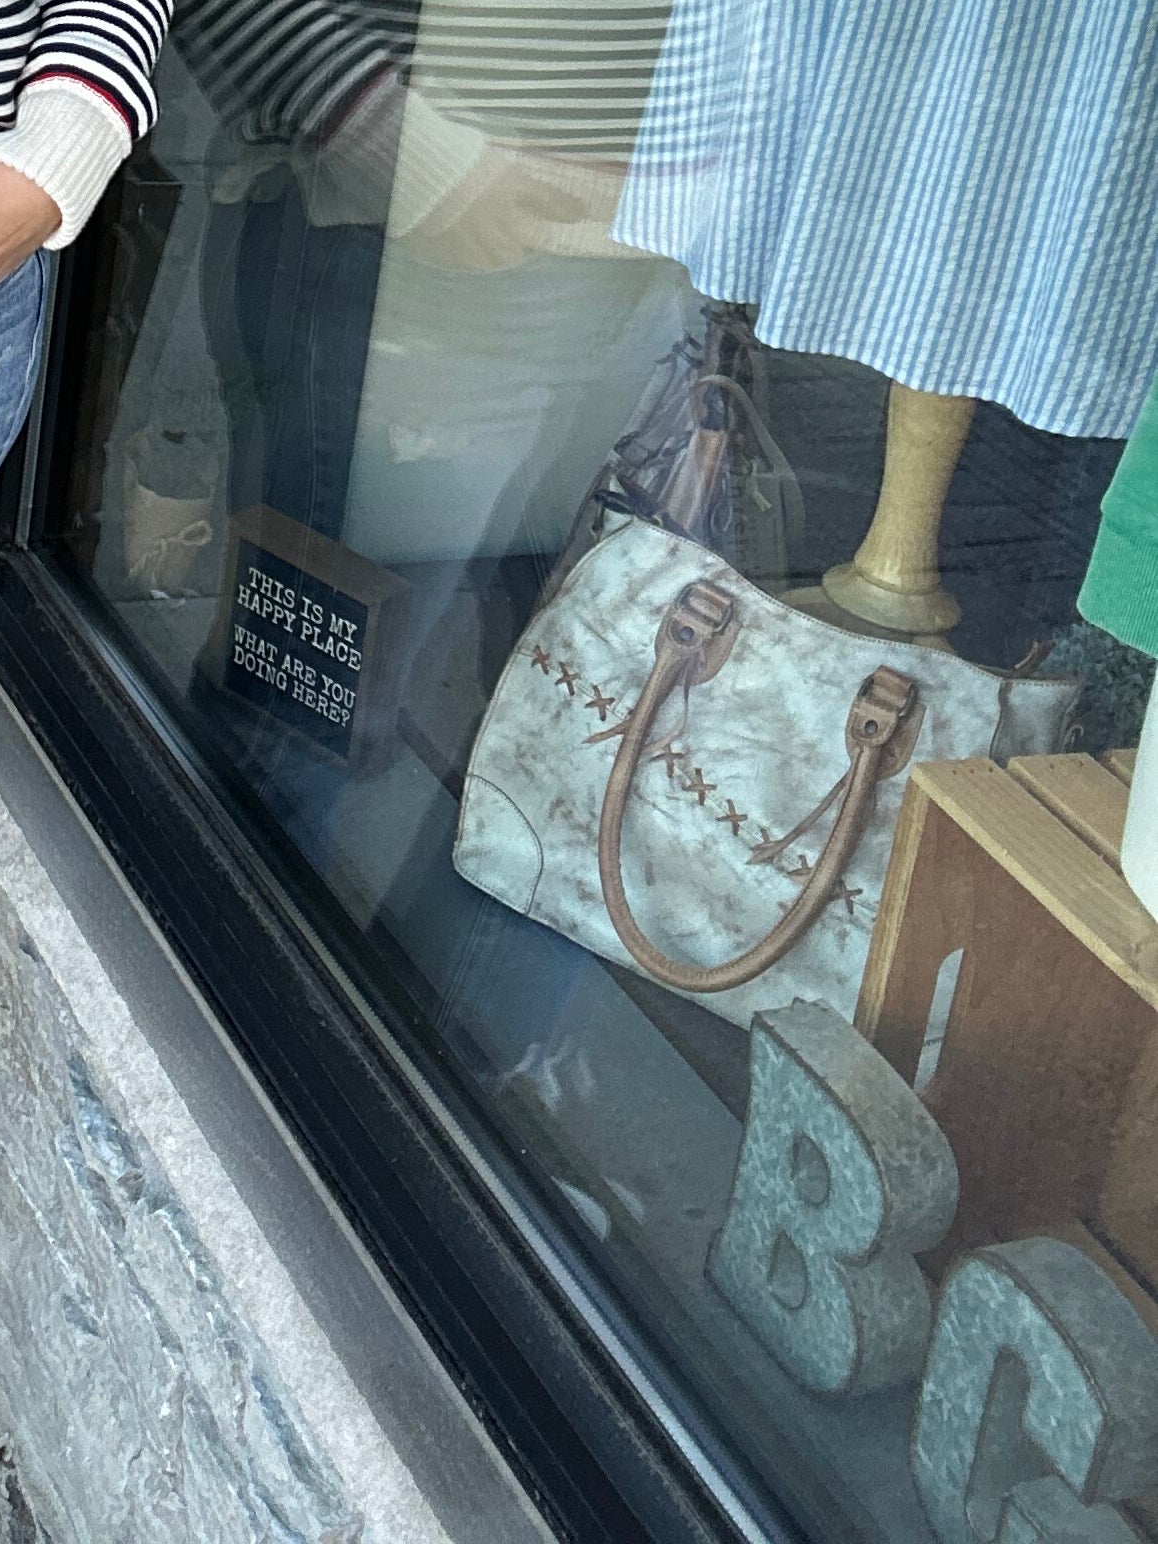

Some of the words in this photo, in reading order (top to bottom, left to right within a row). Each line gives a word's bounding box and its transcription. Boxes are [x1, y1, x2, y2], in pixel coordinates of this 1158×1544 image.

[237, 584, 296, 633] HAPPY
[299, 622, 362, 671] PLACE
[248, 567, 296, 607] THIS
[300, 596, 324, 625] IS
[329, 613, 358, 644] MY
[233, 624, 279, 662] WHAT
[280, 654, 317, 687] ARE
[321, 673, 357, 709] YOU
[233, 645, 288, 691] DOING
[292, 680, 352, 728] HERE?
